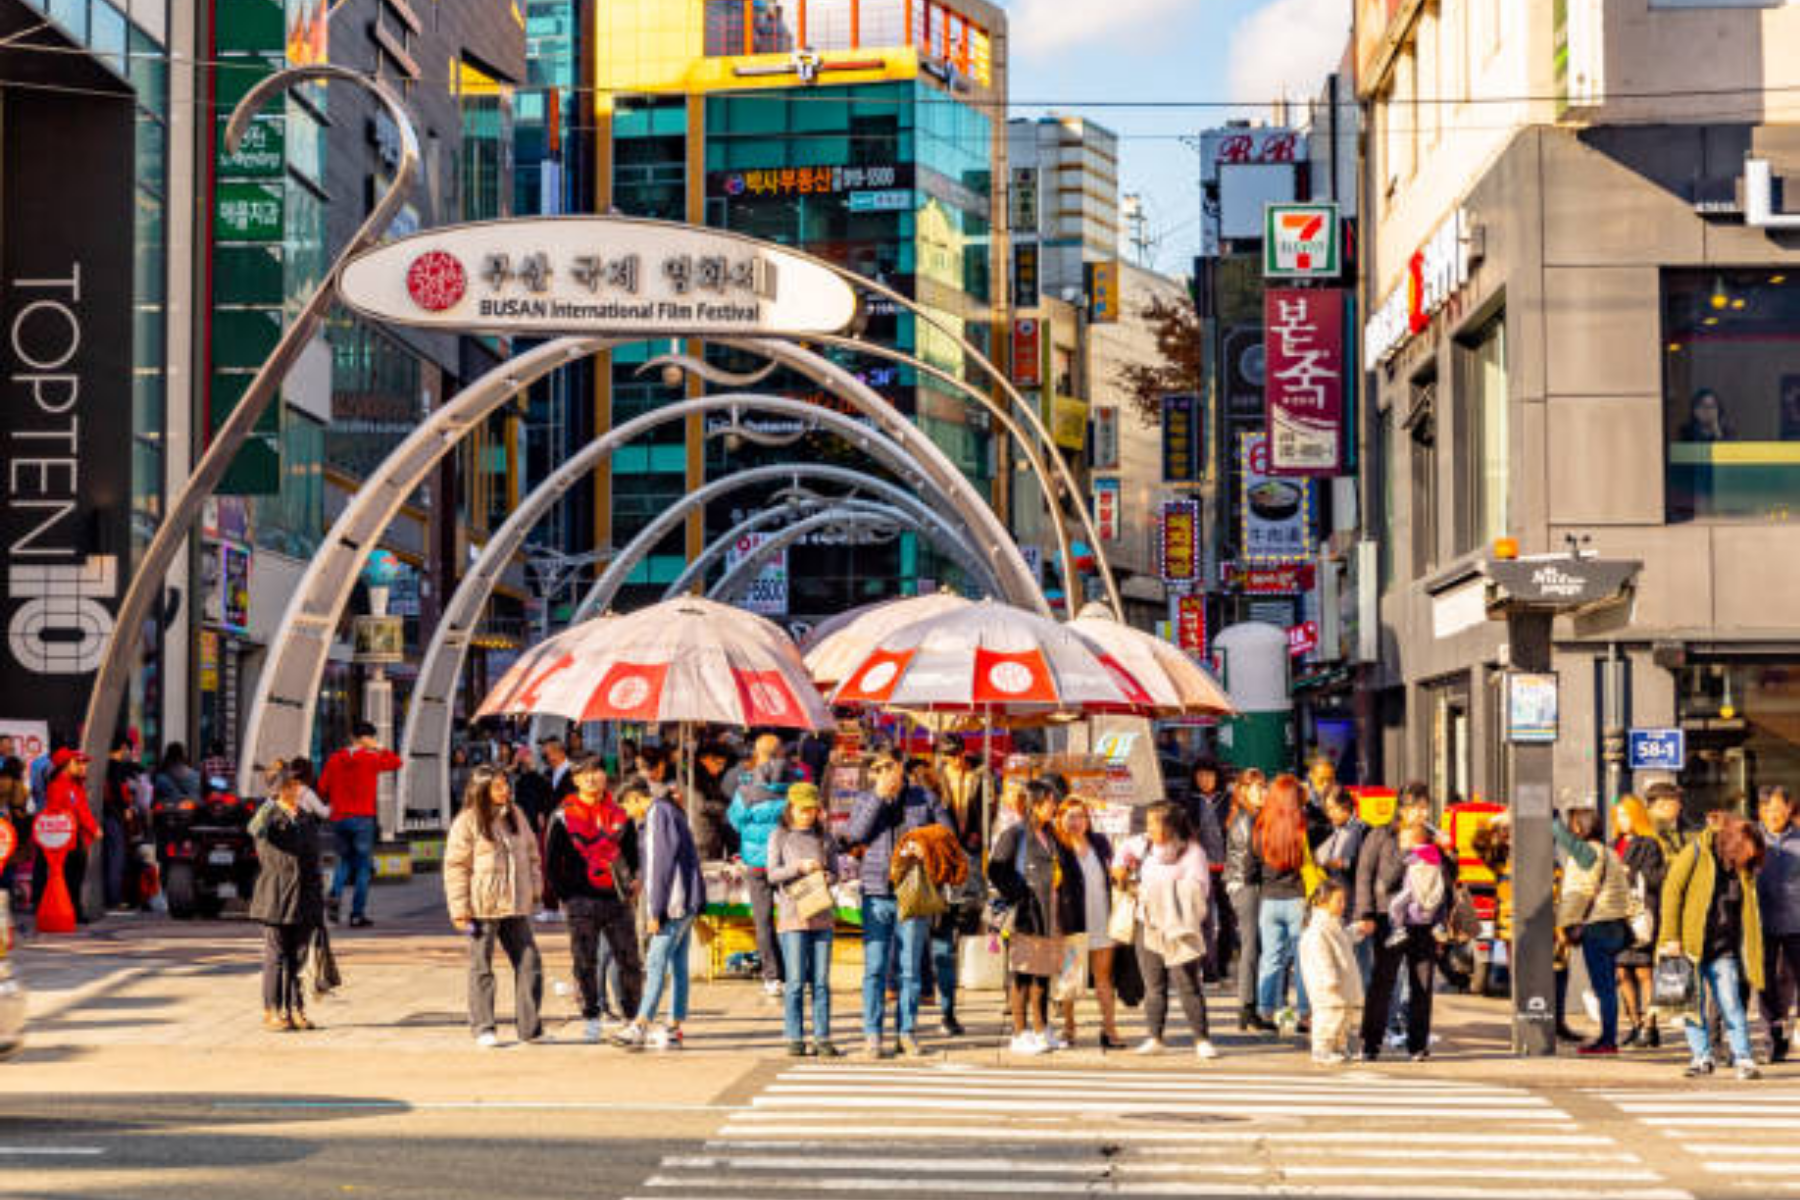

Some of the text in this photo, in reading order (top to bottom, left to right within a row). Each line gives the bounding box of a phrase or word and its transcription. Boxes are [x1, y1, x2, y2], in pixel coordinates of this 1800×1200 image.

[480, 300, 760, 320] BUSAN International Film Festival
[8, 262, 118, 674] TOPTEN 10
[1637, 740, 1675, 757] 58-1
